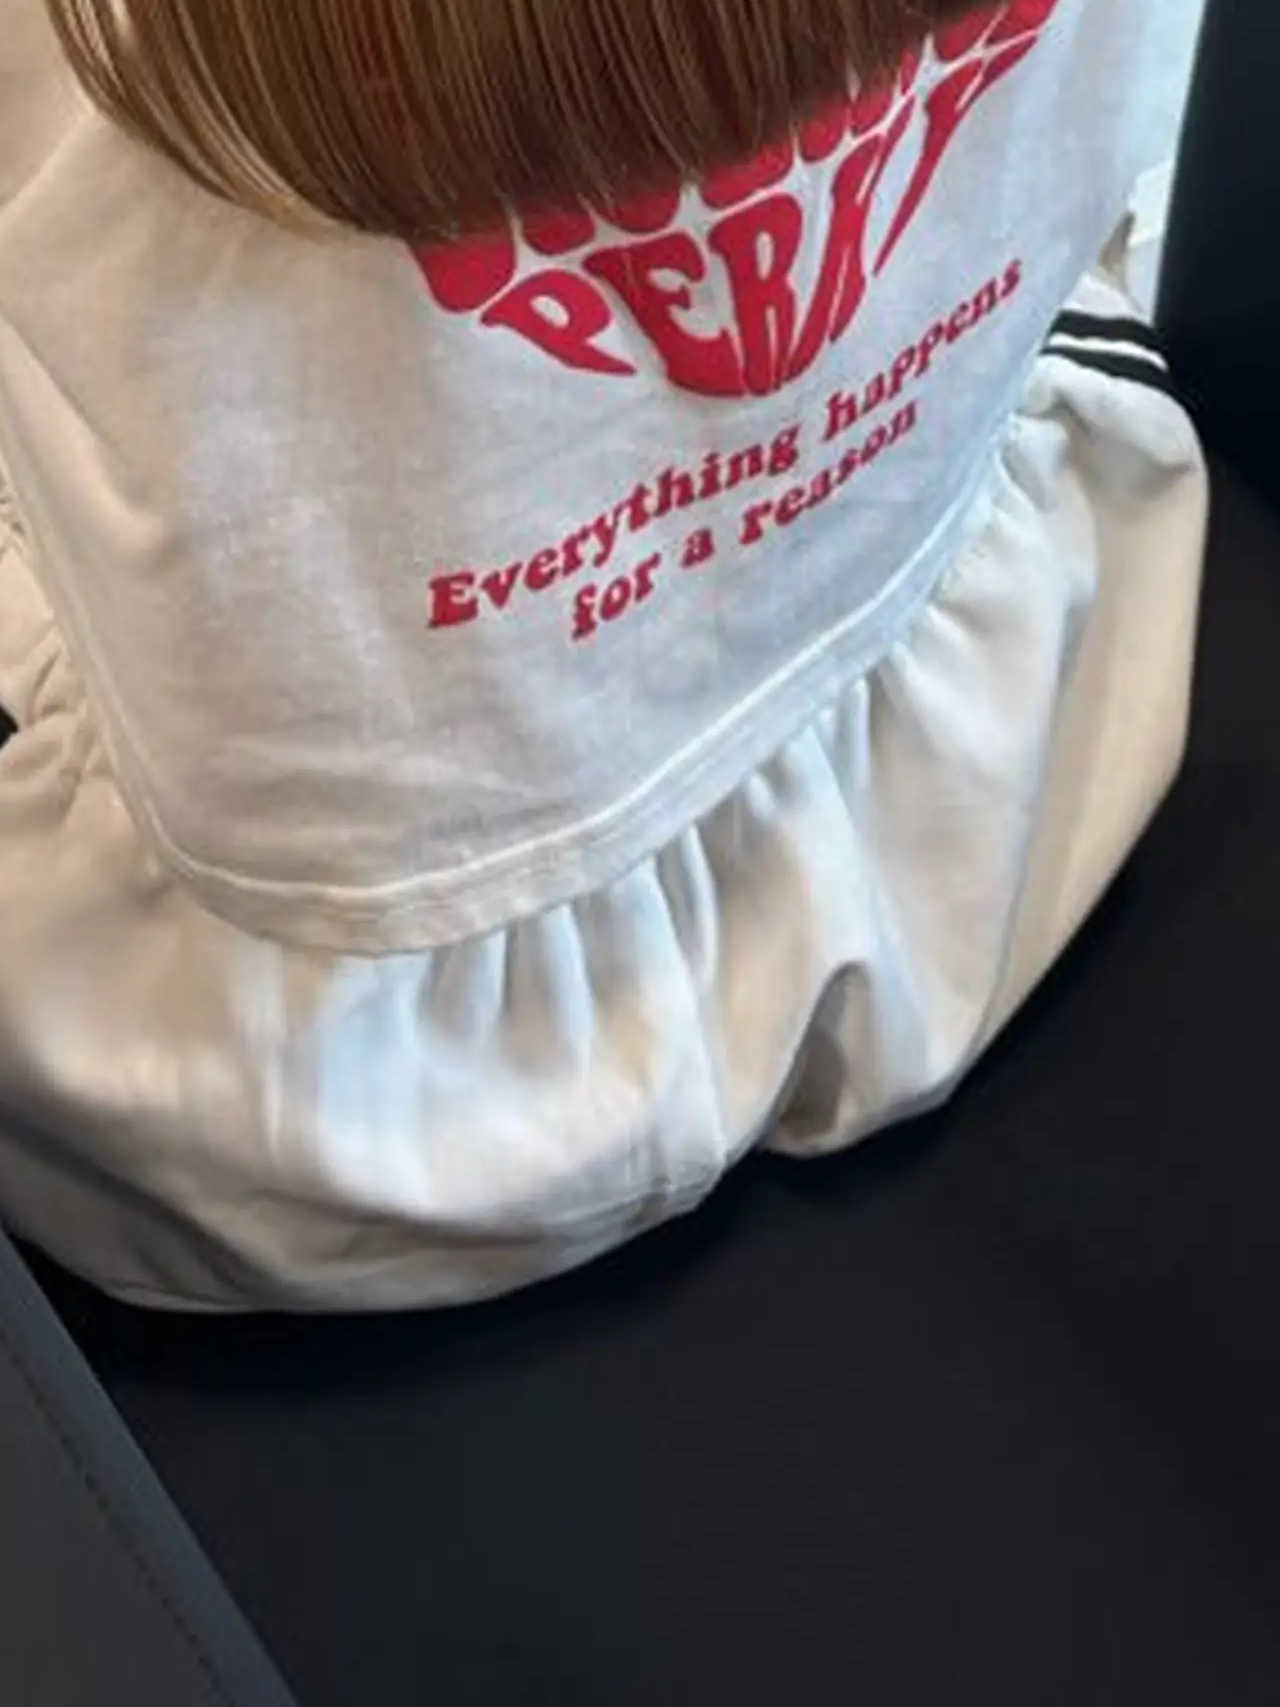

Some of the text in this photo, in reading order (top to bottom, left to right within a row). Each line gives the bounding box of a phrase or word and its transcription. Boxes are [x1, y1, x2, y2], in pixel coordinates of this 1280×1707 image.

[427, 258, 1023, 630] Everything happens
[570, 401, 918, 641] for a reason
